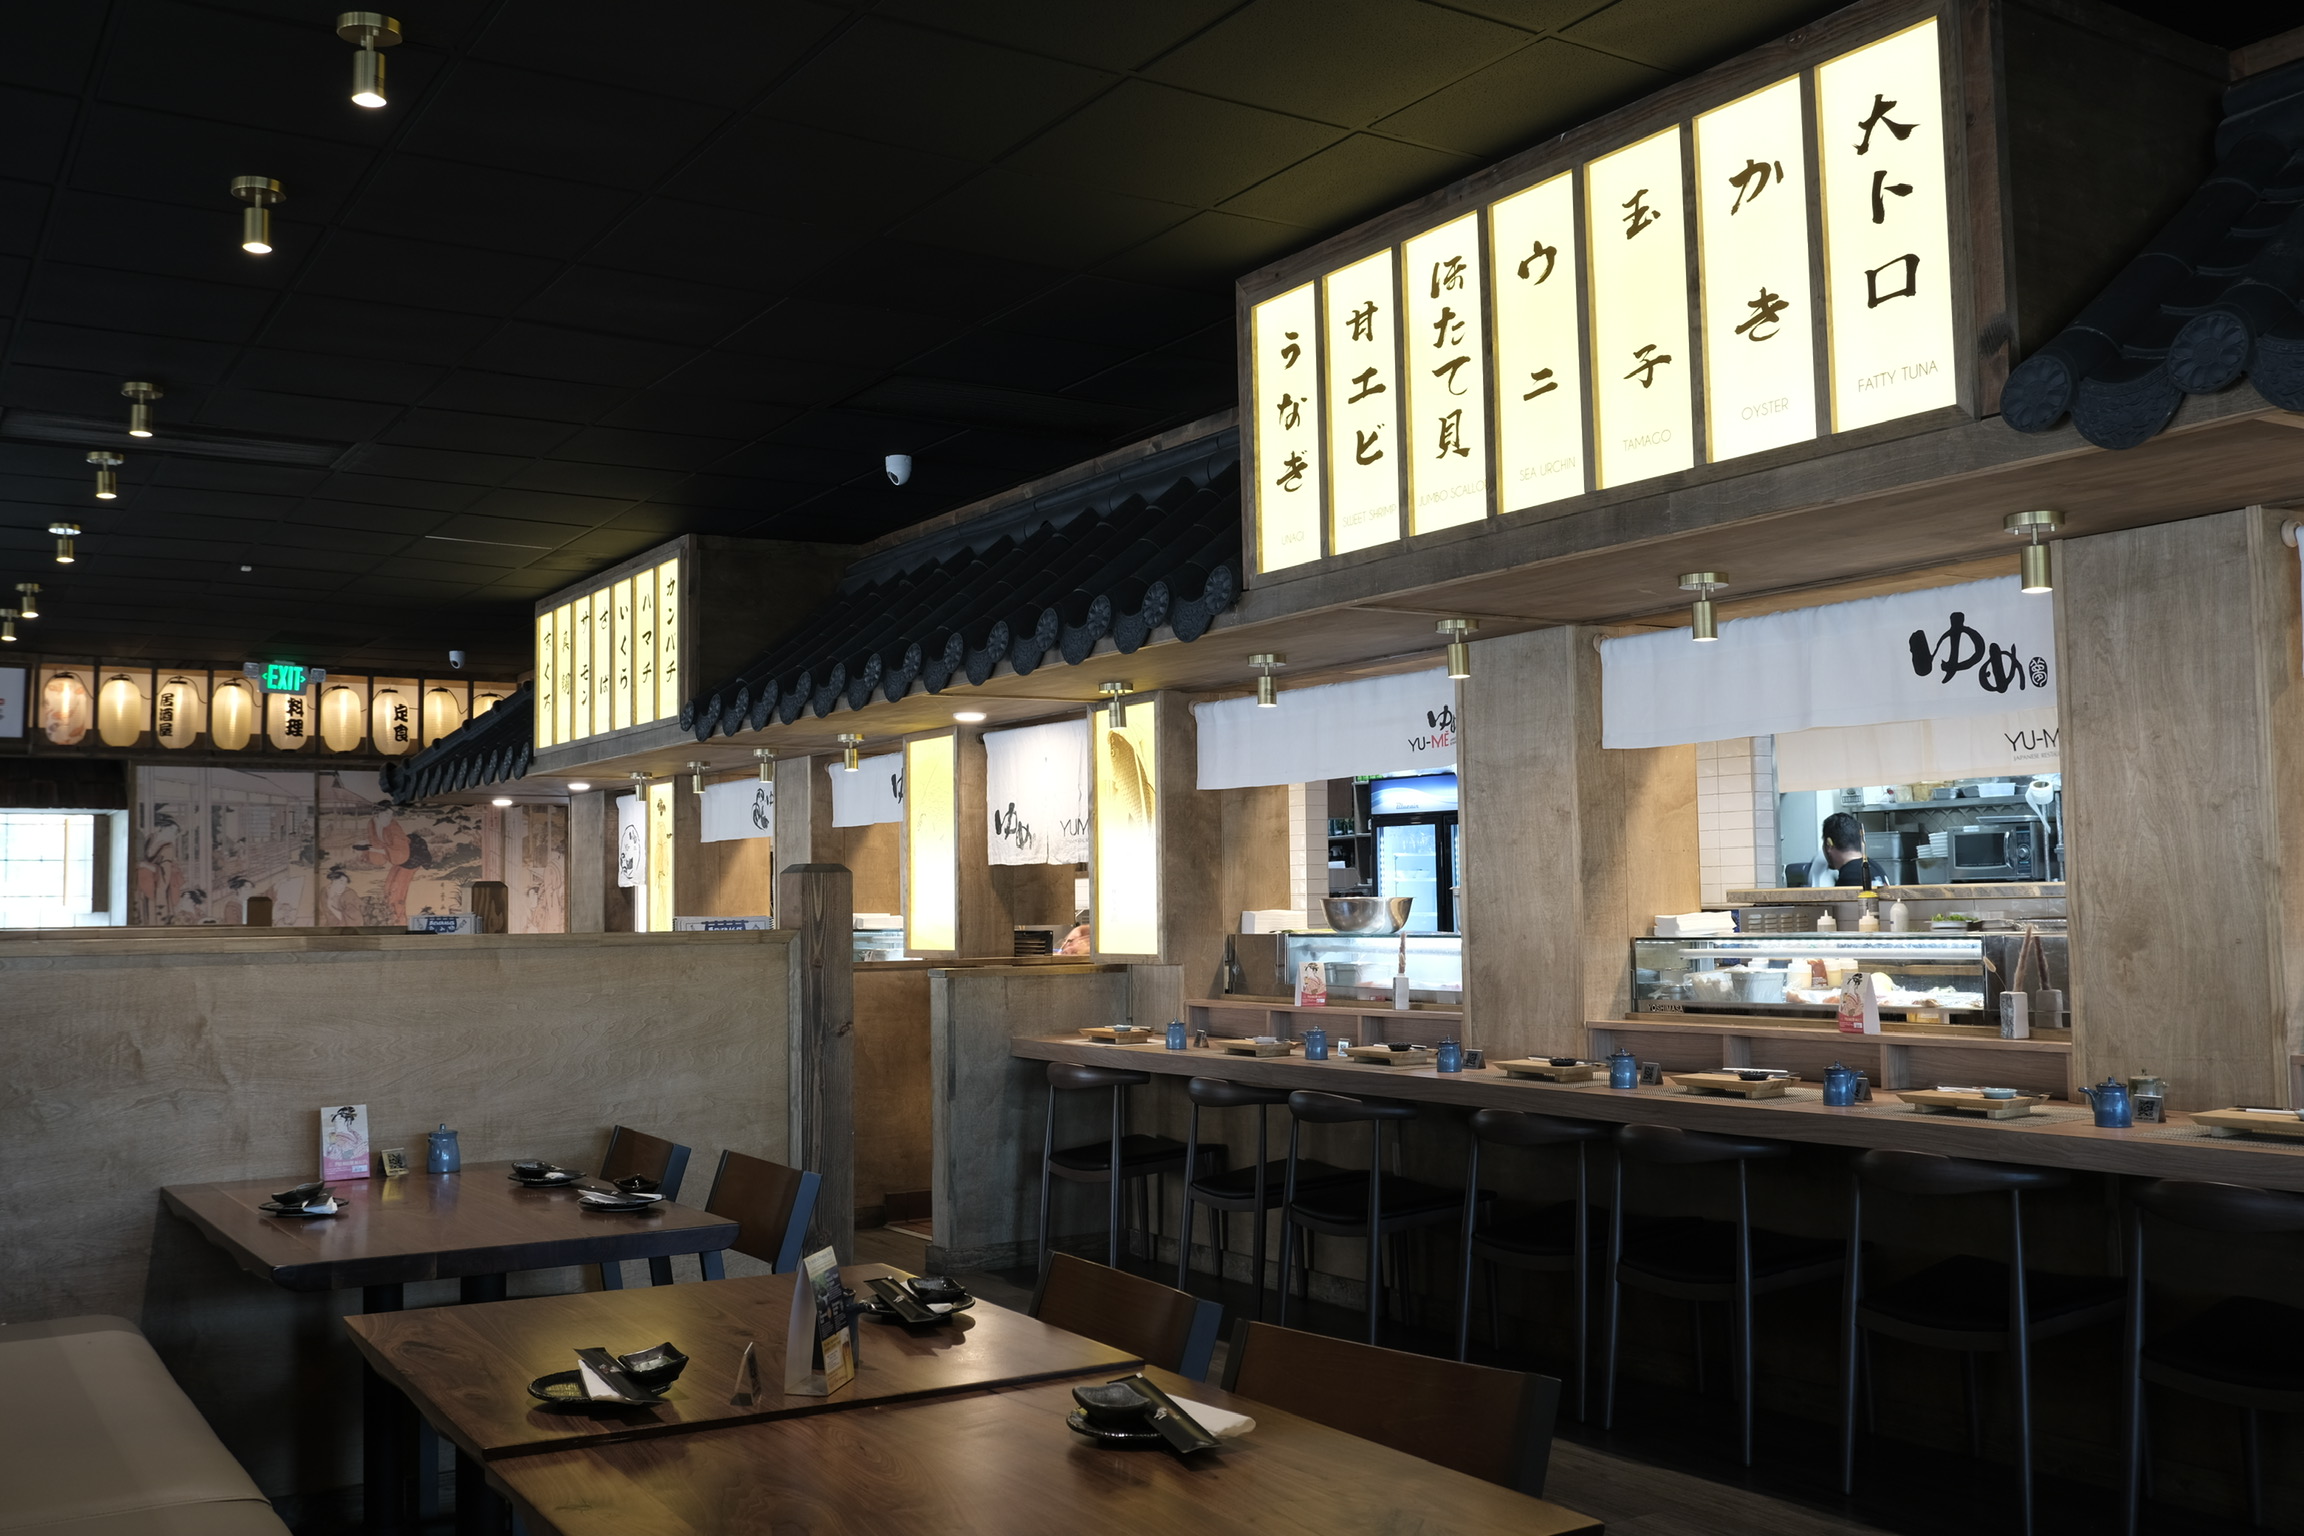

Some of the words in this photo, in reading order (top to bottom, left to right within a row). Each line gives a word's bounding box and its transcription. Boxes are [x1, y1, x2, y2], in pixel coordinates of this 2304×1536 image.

[1852, 93, 1921, 310] 大トロ
[1728, 158, 1789, 343] かき
[1517, 240, 1558, 402] ウニ
[1622, 188, 1672, 389] 玉子
[1345, 301, 1387, 466] 甘エビ
[1430, 256, 1472, 459] ほたて貝
[1857, 369, 1897, 393] FATTY
[1901, 359, 1939, 382] TUNA
[1276, 331, 1308, 493] うなぎ
[1621, 428, 1672, 452] TAMAGO
[1740, 396, 1789, 421] OYSTER
[1418, 489, 1449, 507] JUMBO
[1519, 467, 1537, 482] SEA
[1539, 456, 1576, 478] URCHIN
[1342, 510, 1367, 528] SWEET
[1369, 503, 1397, 521] SHRIMP
[580, 610, 590, 706] サーモン
[619, 605, 629, 690] いくら
[642, 593, 652, 684] ハマチ
[1908, 611, 2026, 694] ゆめ
[267, 664, 304, 691] EXIT
[159, 692, 175, 737] 居酒屋
[284, 696, 304, 737] 料理
[393, 703, 409, 742] 定食
[994, 802, 1032, 850] ゆめ
